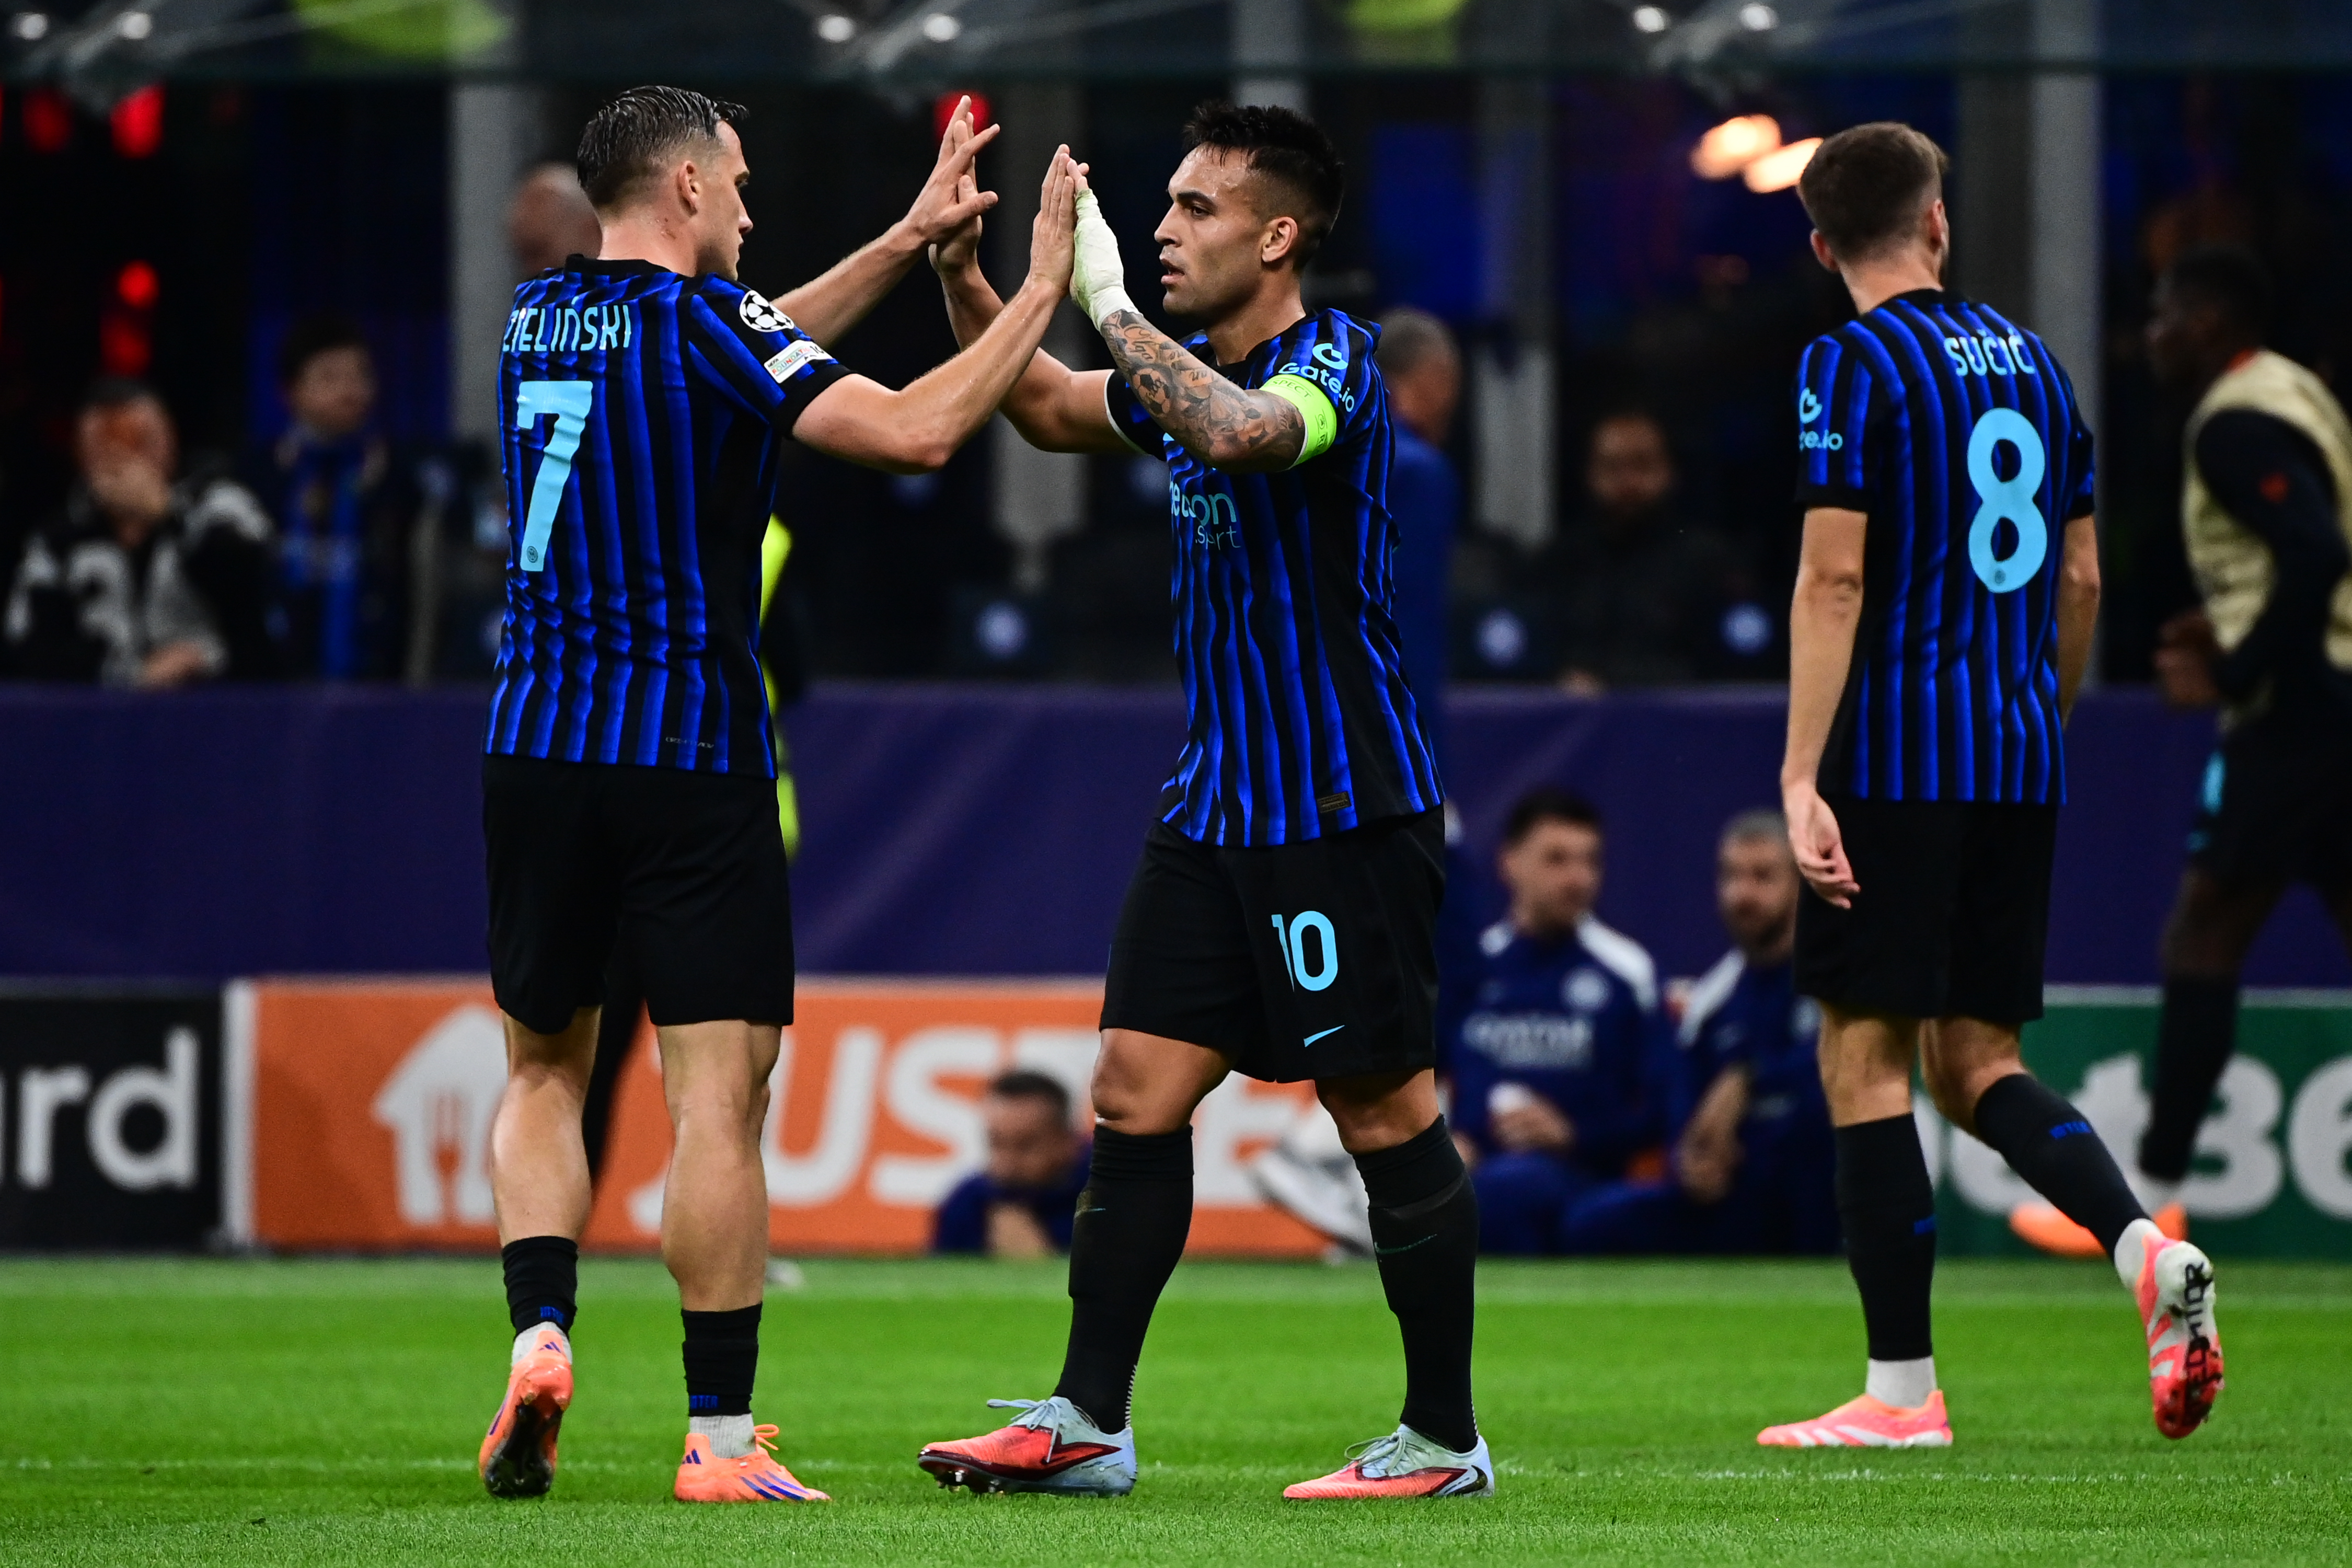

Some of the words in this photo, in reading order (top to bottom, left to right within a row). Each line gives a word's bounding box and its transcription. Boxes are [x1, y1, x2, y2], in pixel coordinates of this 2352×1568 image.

[1278, 363, 1355, 412] Gate.io
[1944, 327, 2035, 376] SUČIĆ
[517, 381, 593, 571] 7
[1967, 408, 2047, 593] 8
[1271, 910, 1338, 992] 10
